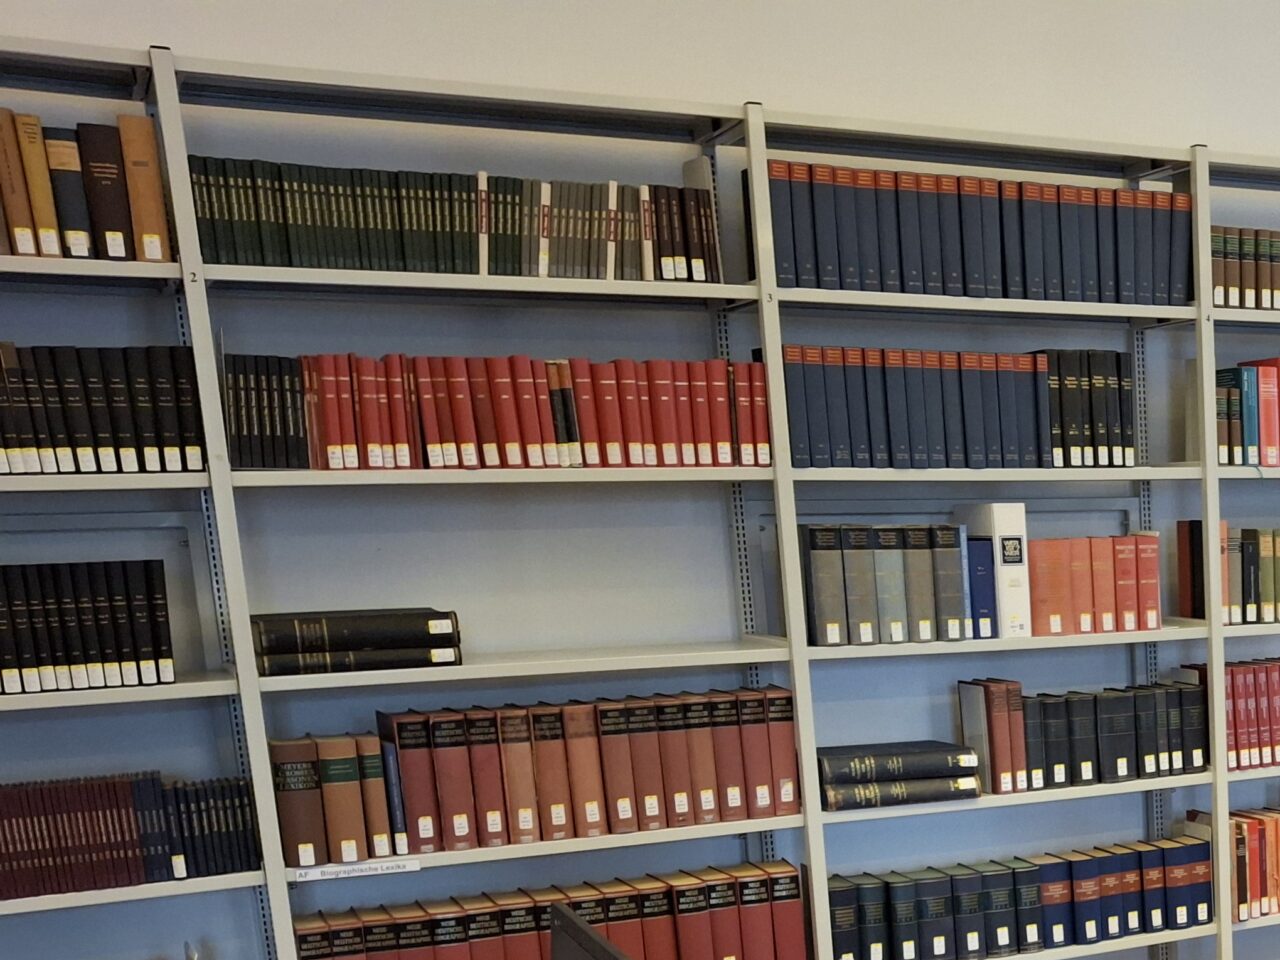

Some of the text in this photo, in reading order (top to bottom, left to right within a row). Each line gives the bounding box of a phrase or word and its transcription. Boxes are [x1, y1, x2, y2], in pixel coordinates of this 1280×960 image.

[189, 271, 198, 283] 2
[766, 293, 773, 303] 3
[298, 863, 407, 879] AF Biographische Lexika
